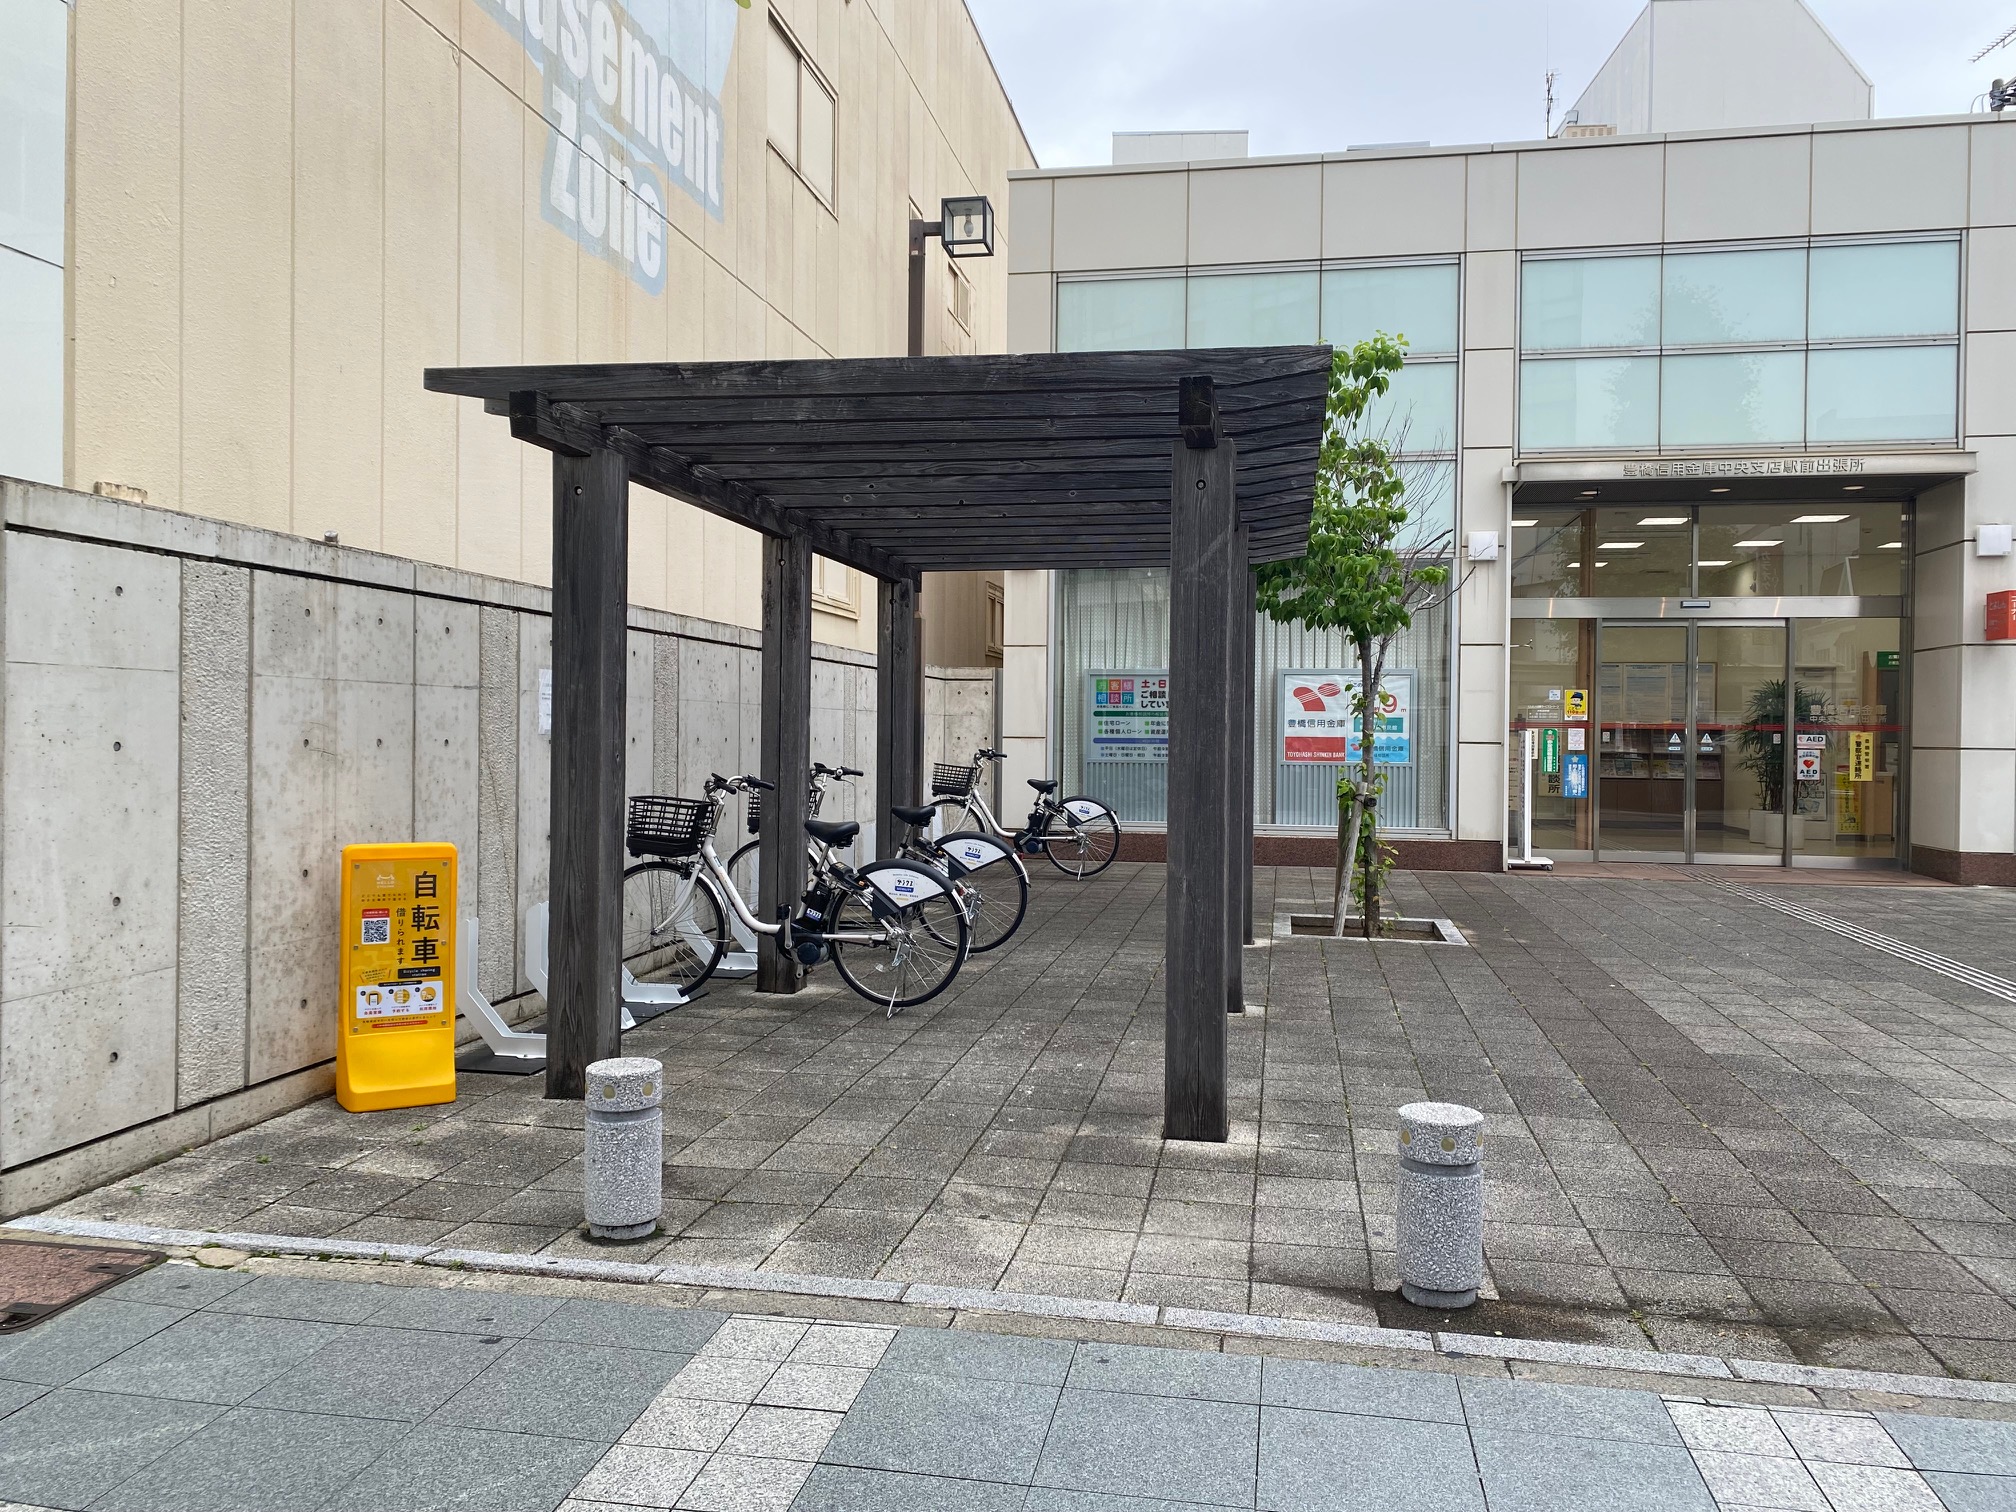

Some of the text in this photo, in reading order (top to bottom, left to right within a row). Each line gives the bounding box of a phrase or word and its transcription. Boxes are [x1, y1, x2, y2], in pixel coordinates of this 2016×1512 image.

[551, 83, 662, 279] Zone
[1141, 690, 1169, 699] ご相談
[1288, 719, 1346, 728] 豊橋信用金庫
[396, 907, 406, 965] 借りられます
[411, 871, 440, 964] 自転車
